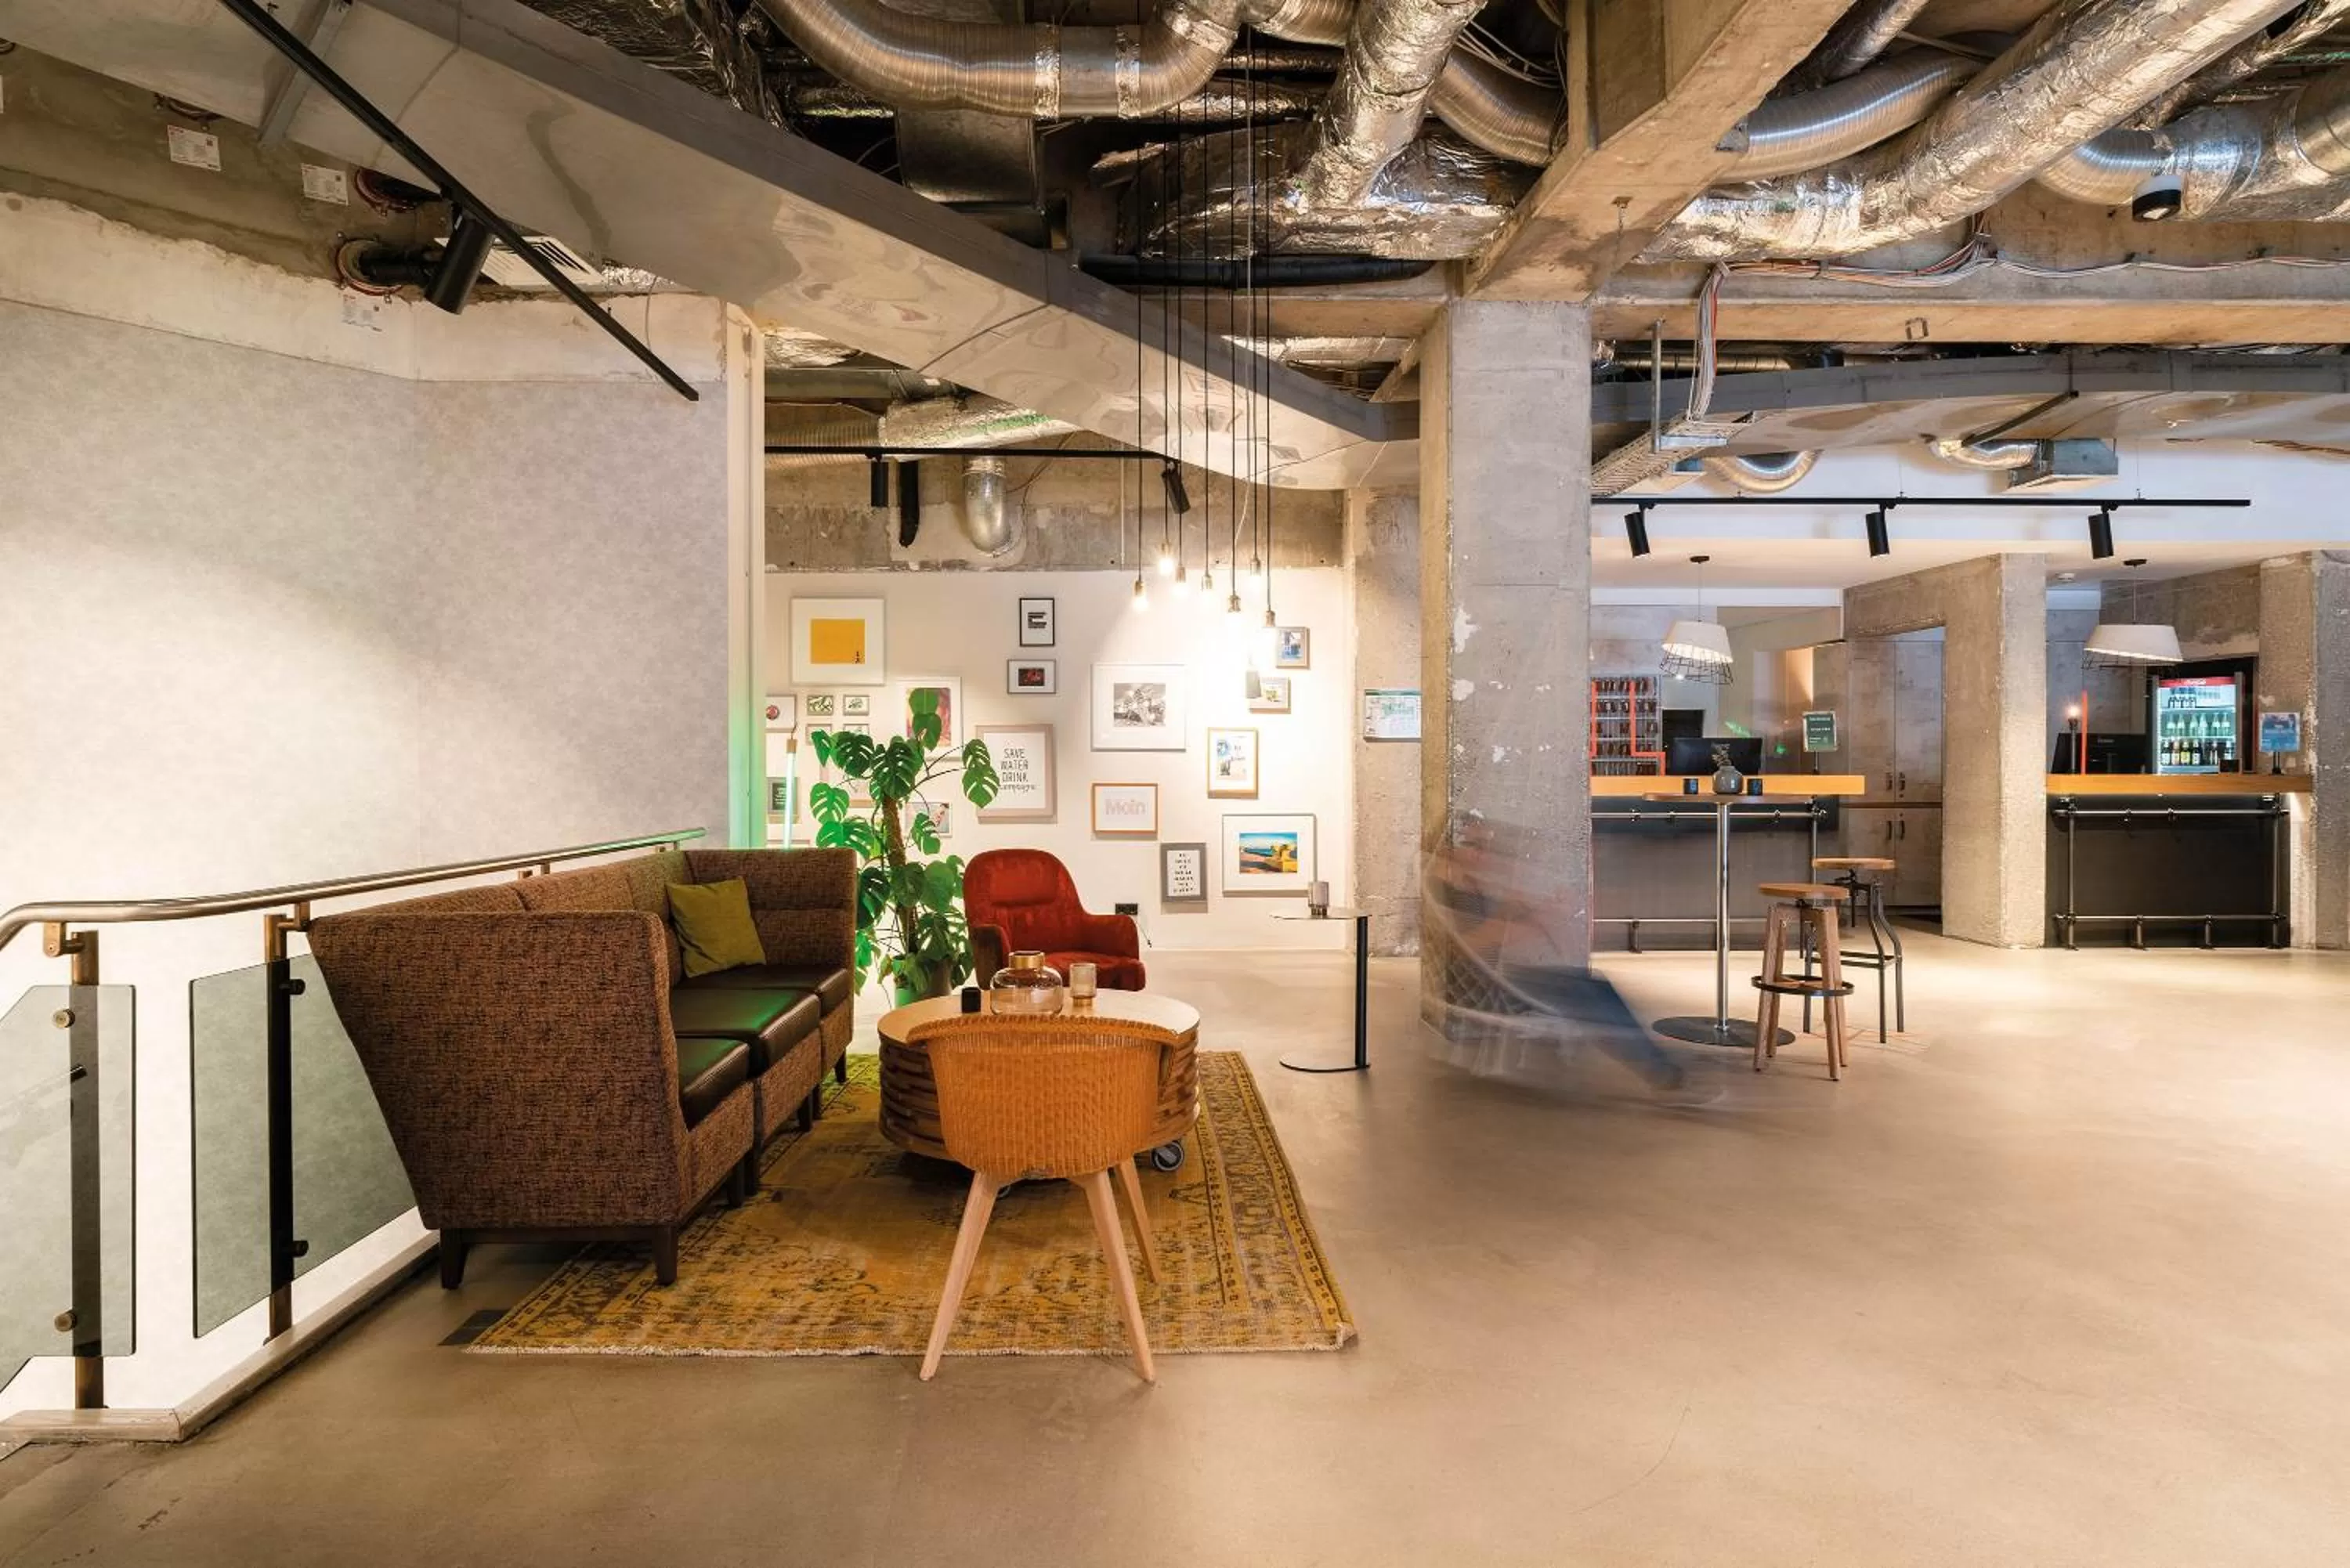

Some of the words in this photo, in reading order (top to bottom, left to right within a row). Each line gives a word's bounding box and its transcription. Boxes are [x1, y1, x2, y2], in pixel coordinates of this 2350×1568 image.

[1003, 748, 1025, 758] SAVE
[1001, 760, 1029, 771] WATER
[1002, 771, 1029, 782] DRINK
[1105, 798, 1147, 815] Moin
